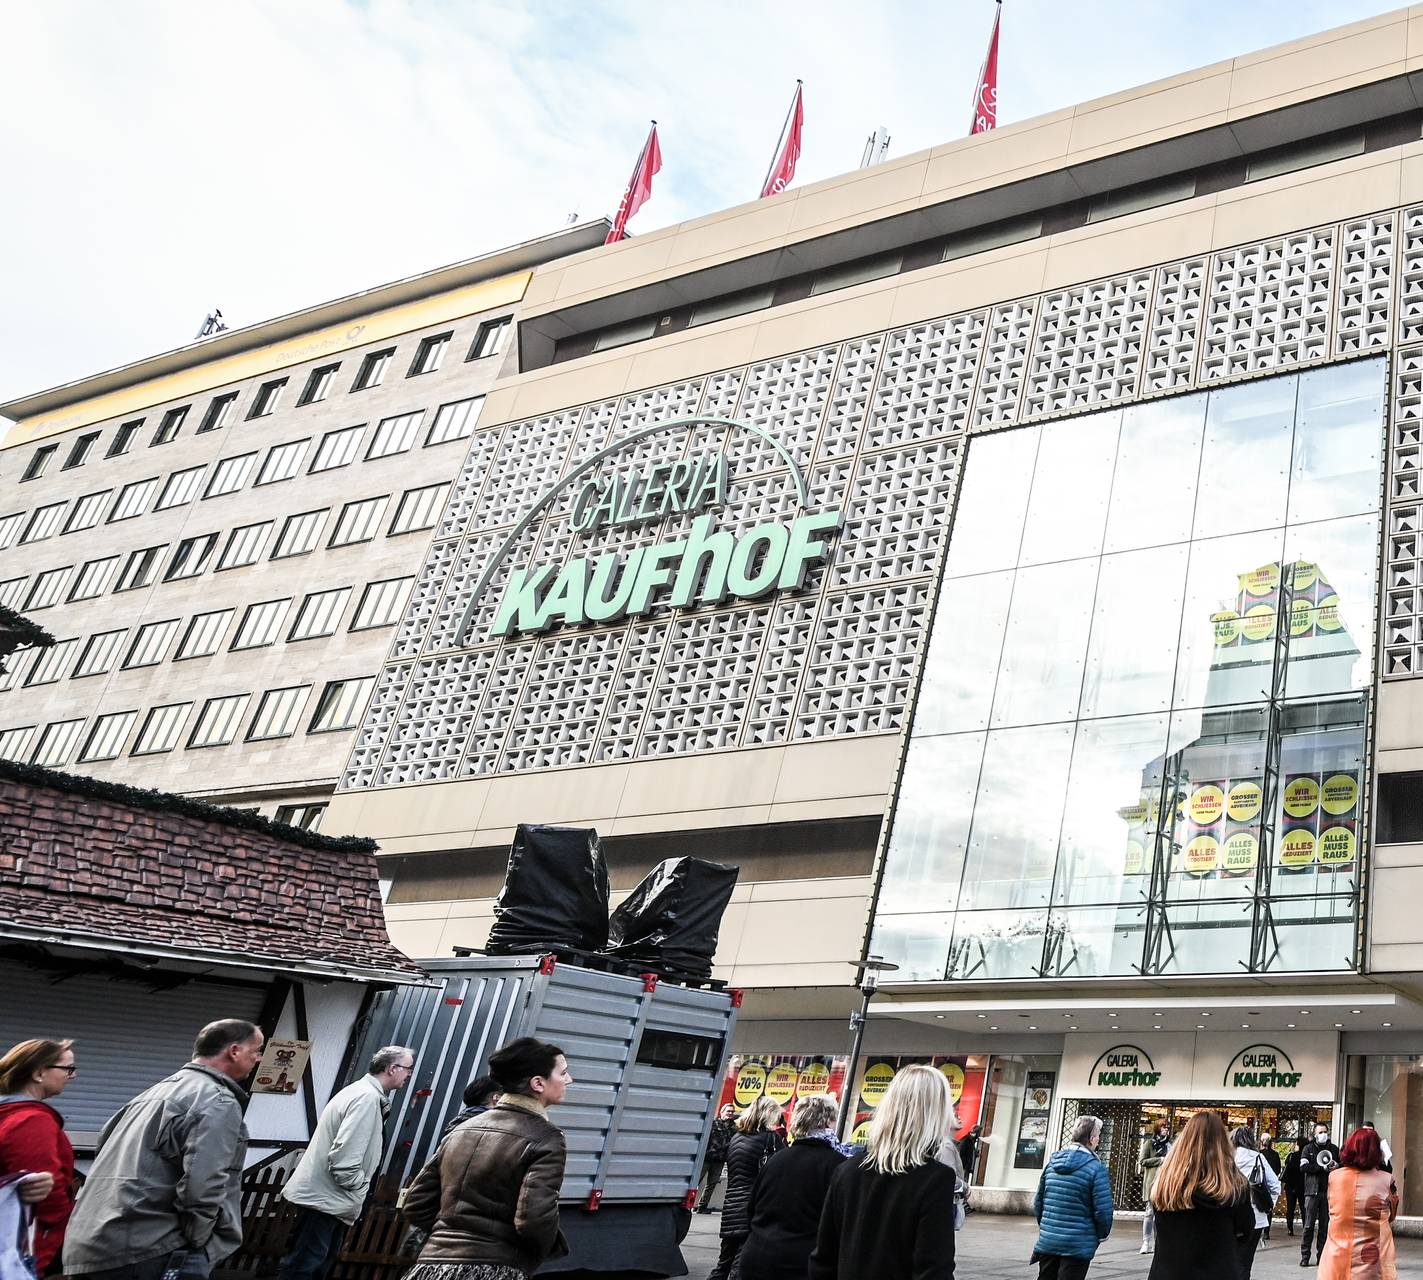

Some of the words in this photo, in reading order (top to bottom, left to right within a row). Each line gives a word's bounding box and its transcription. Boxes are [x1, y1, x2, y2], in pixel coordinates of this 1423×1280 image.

[569, 451, 728, 534] GALERIA
[1294, 788, 1309, 796] WIR
[1324, 833, 1349, 842] ALLES
[1228, 840, 1252, 848] ALLES
[1323, 842, 1349, 851] MUSS
[1188, 848, 1216, 857] ALLES
[1228, 848, 1252, 856] MUSS
[1322, 850, 1348, 859] RAUS
[1227, 856, 1251, 864] RAUS
[1107, 1054, 1138, 1067] GALERIA
[1242, 1054, 1276, 1068] GALERIA
[738, 1077, 761, 1090] -70%
[800, 1076, 827, 1084] ALLES
